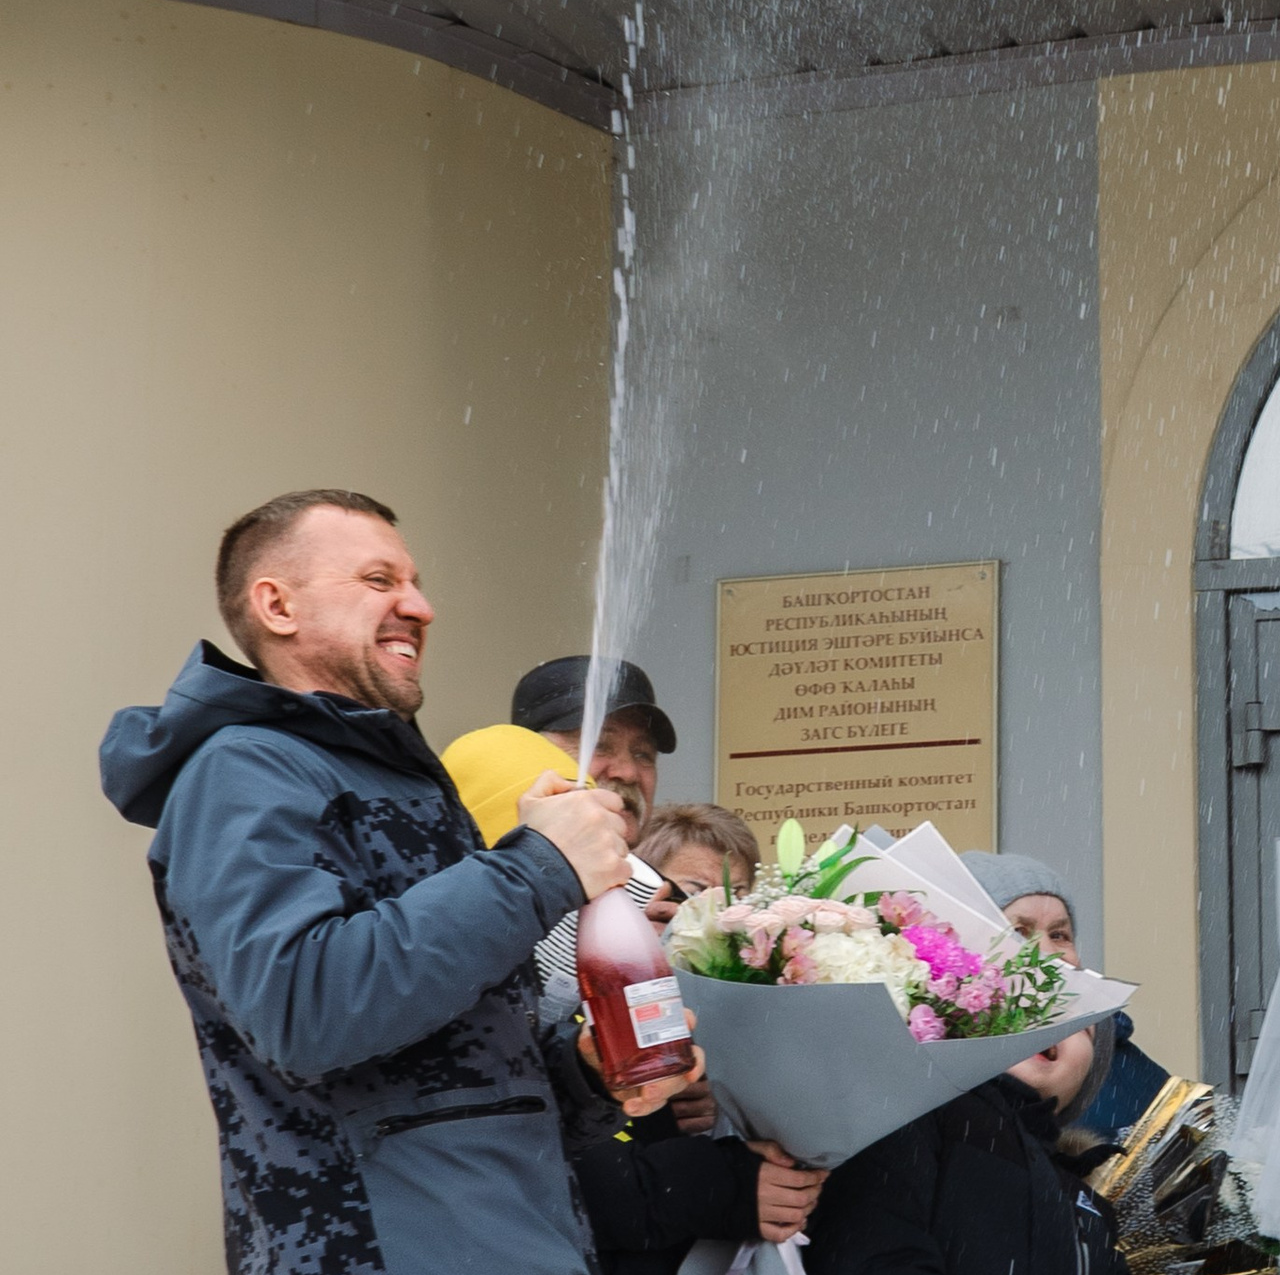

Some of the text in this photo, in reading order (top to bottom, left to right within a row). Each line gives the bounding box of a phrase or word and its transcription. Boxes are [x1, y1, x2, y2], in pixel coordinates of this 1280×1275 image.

[729, 627, 984, 657] ЮСТИЦИЯ ЭШТӘРЕ БУЙЫНСА
[843, 652, 943, 672] КОМИТЕТЫ
[773, 704, 814, 722] ДИМ
[800, 725, 843, 742] ЗАГС
[735, 772, 976, 800] Государственный комитет
[843, 798, 977, 820] Башкортостан
